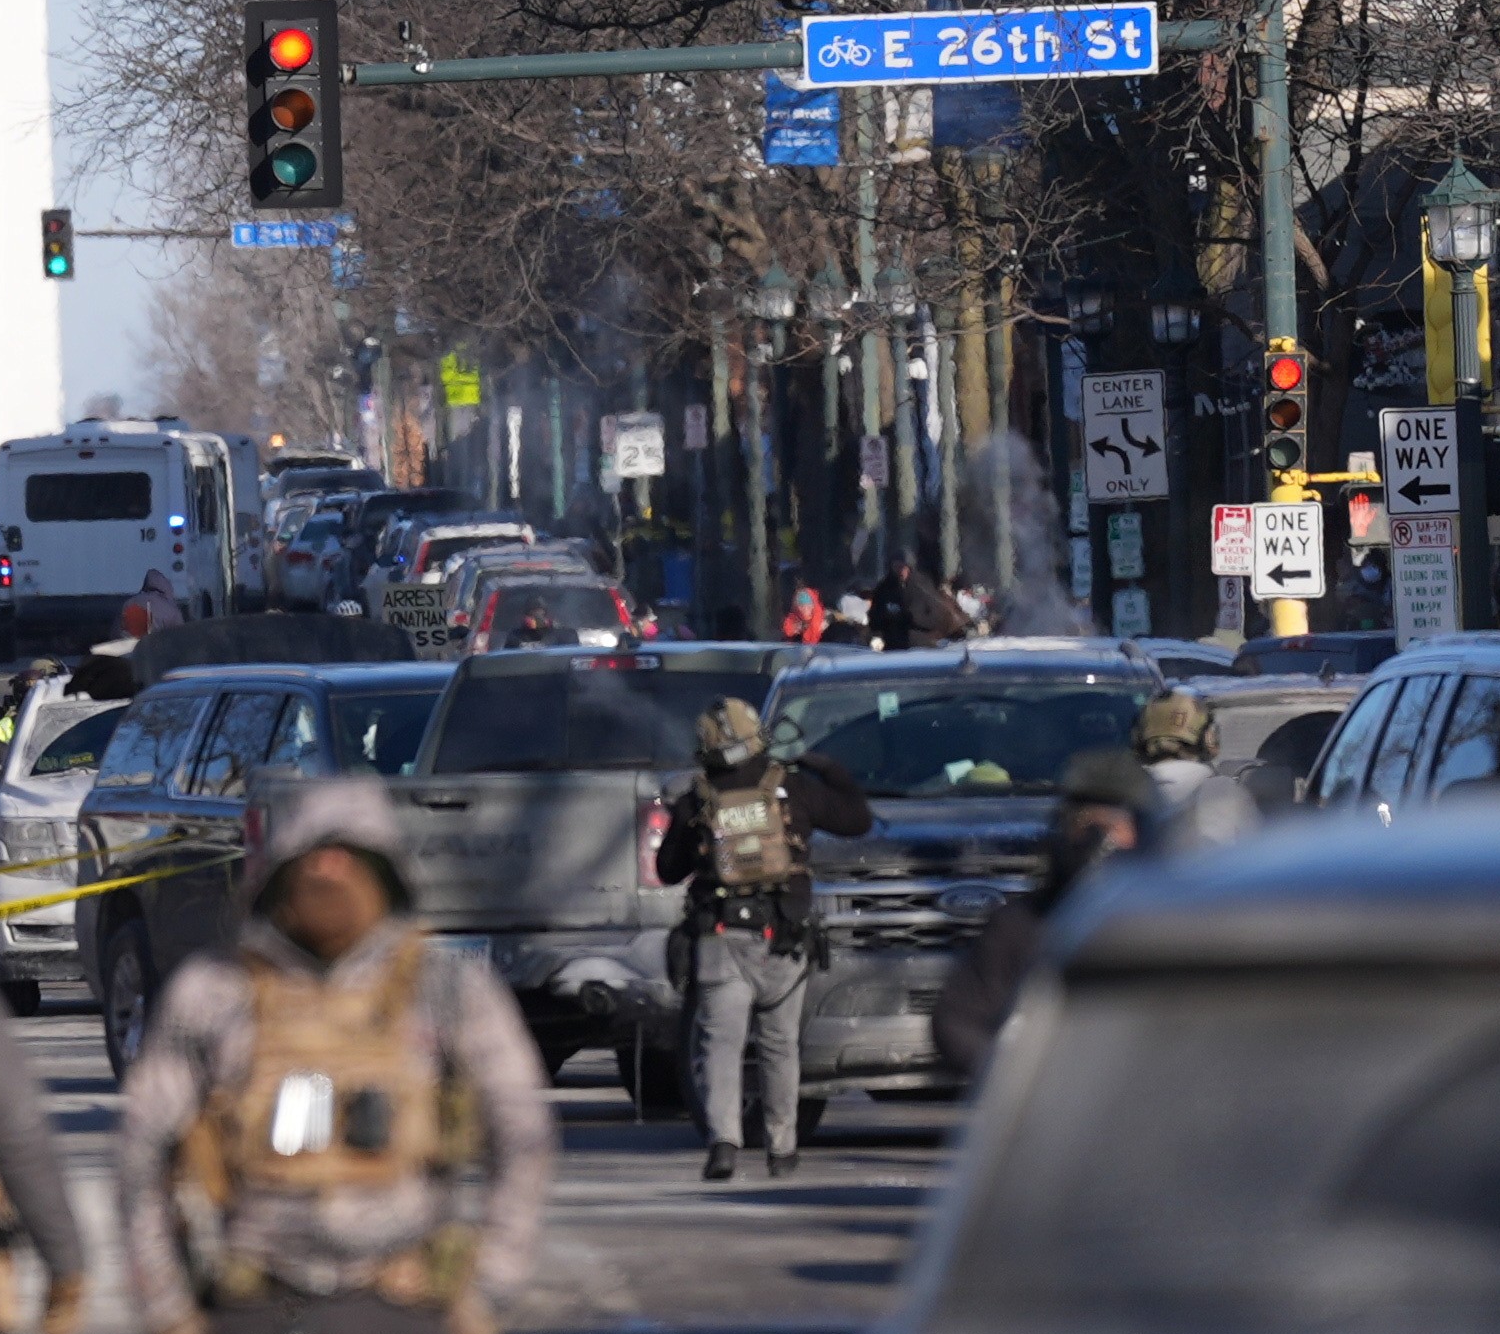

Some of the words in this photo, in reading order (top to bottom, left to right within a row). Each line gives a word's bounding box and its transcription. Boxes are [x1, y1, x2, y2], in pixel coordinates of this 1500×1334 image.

[883, 30, 914, 69] E
[936, 24, 1060, 67] 26th
[1084, 19, 1142, 61] St
[1092, 378, 1155, 394] CENTER
[1102, 395, 1145, 409] LANE
[1396, 417, 1448, 442] ONE
[1394, 445, 1450, 471] WAY
[1105, 478, 1150, 494] ONLY
[1265, 511, 1309, 532] ONE
[1263, 536, 1310, 557] WAY
[382, 589, 445, 608] ARREST
[415, 629, 447, 647] SS
